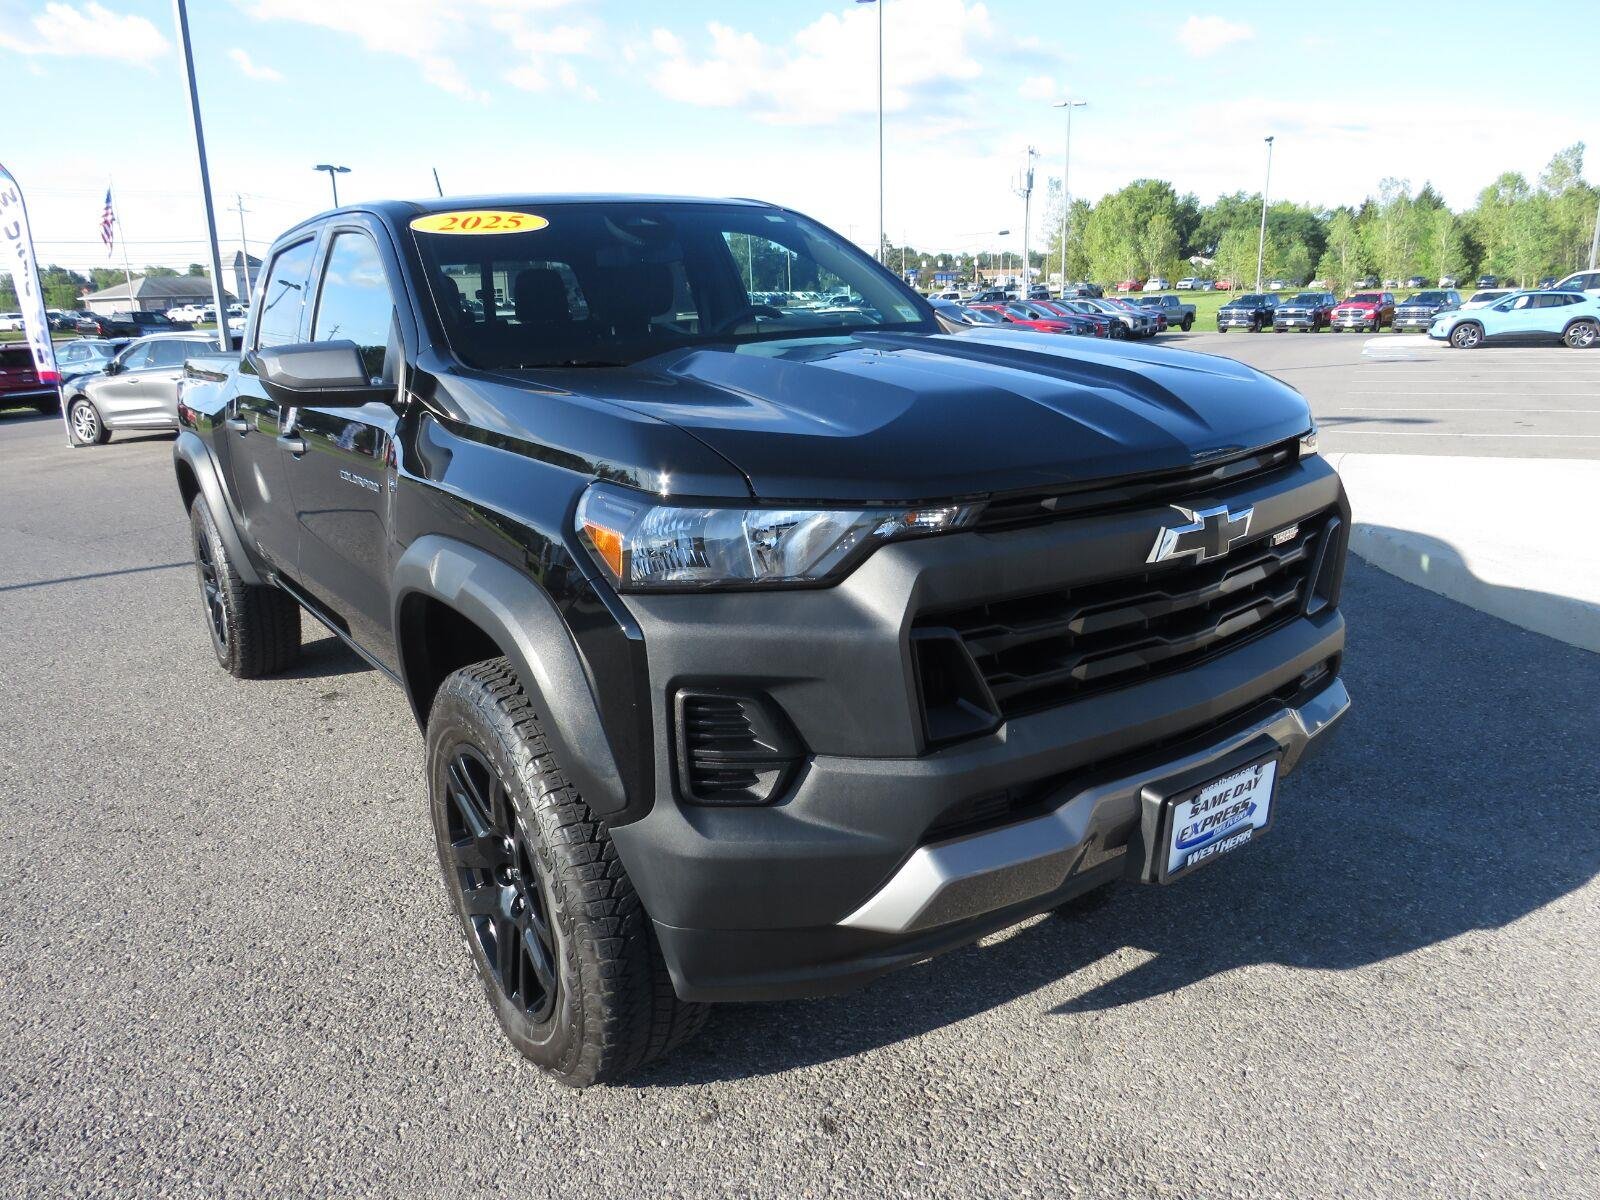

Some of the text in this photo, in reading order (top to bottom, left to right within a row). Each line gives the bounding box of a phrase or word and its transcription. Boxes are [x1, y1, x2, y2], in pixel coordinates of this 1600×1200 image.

[438, 215, 525, 231] 2025
[1189, 773, 1264, 819] SAME DAY
[1180, 797, 1252, 842] EXPRESS
